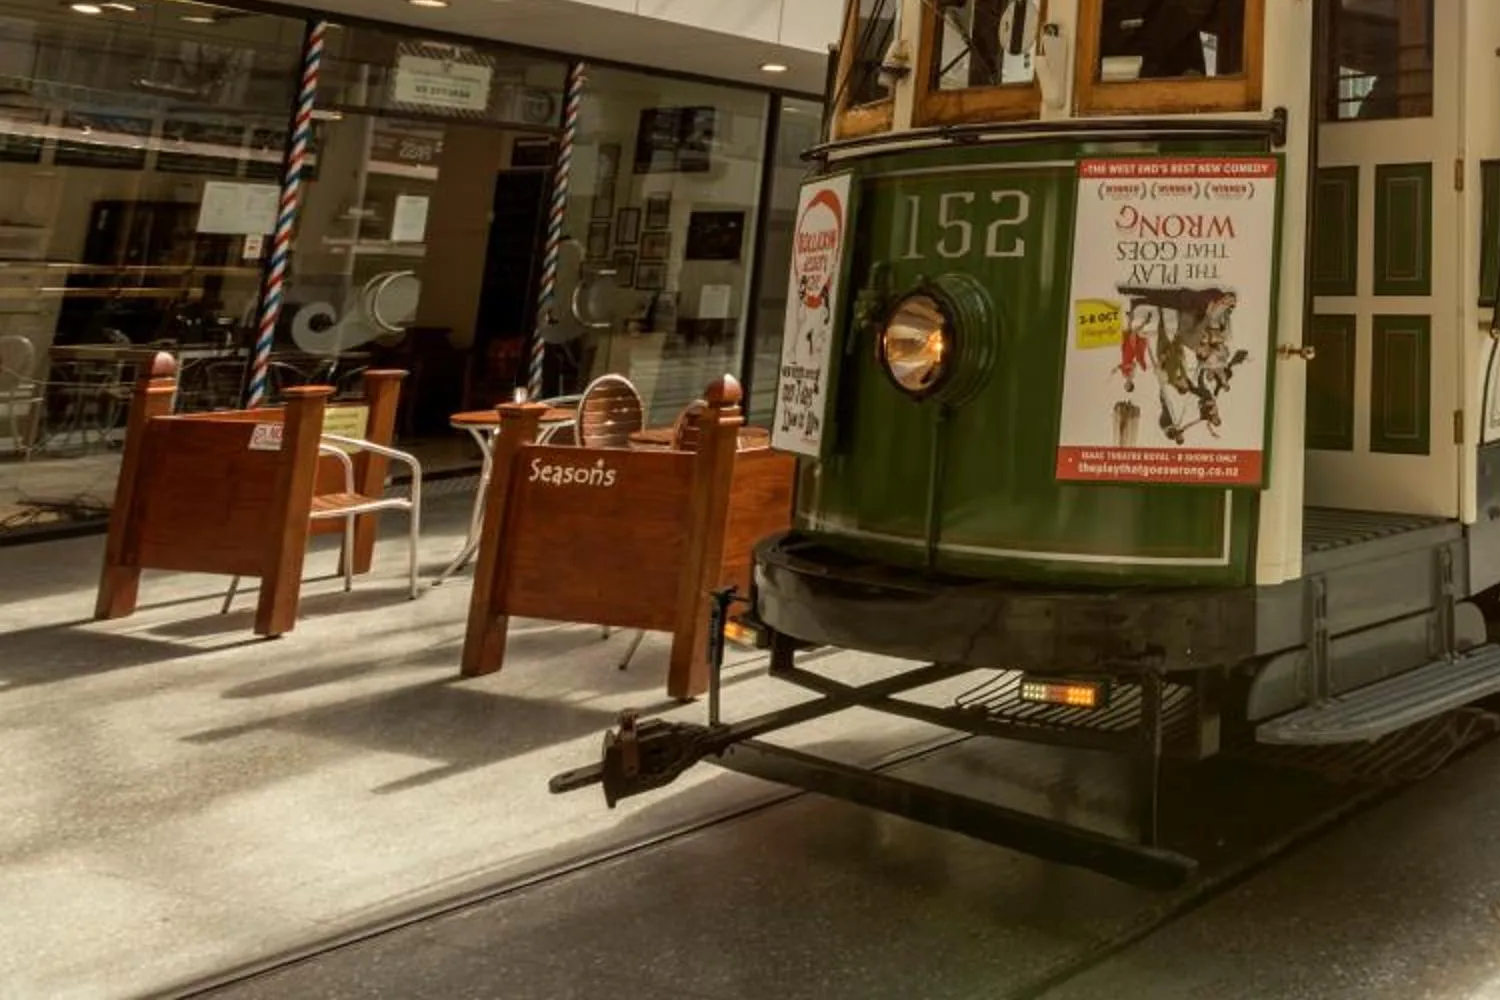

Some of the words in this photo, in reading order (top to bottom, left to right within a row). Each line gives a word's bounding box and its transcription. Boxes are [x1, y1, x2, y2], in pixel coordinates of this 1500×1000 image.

[1223, 163, 1269, 175] COMEDY
[901, 189, 1030, 260] 152
[1115, 204, 1236, 240] WRONG
[1116, 240, 1177, 262] GOES
[1183, 242, 1229, 259] THAT
[1127, 262, 1179, 286] PLAY
[1186, 263, 1220, 280] THE
[1098, 311, 1120, 323] OCT
[1077, 461, 1240, 478] theplaythatgoeswrong.co.nz
